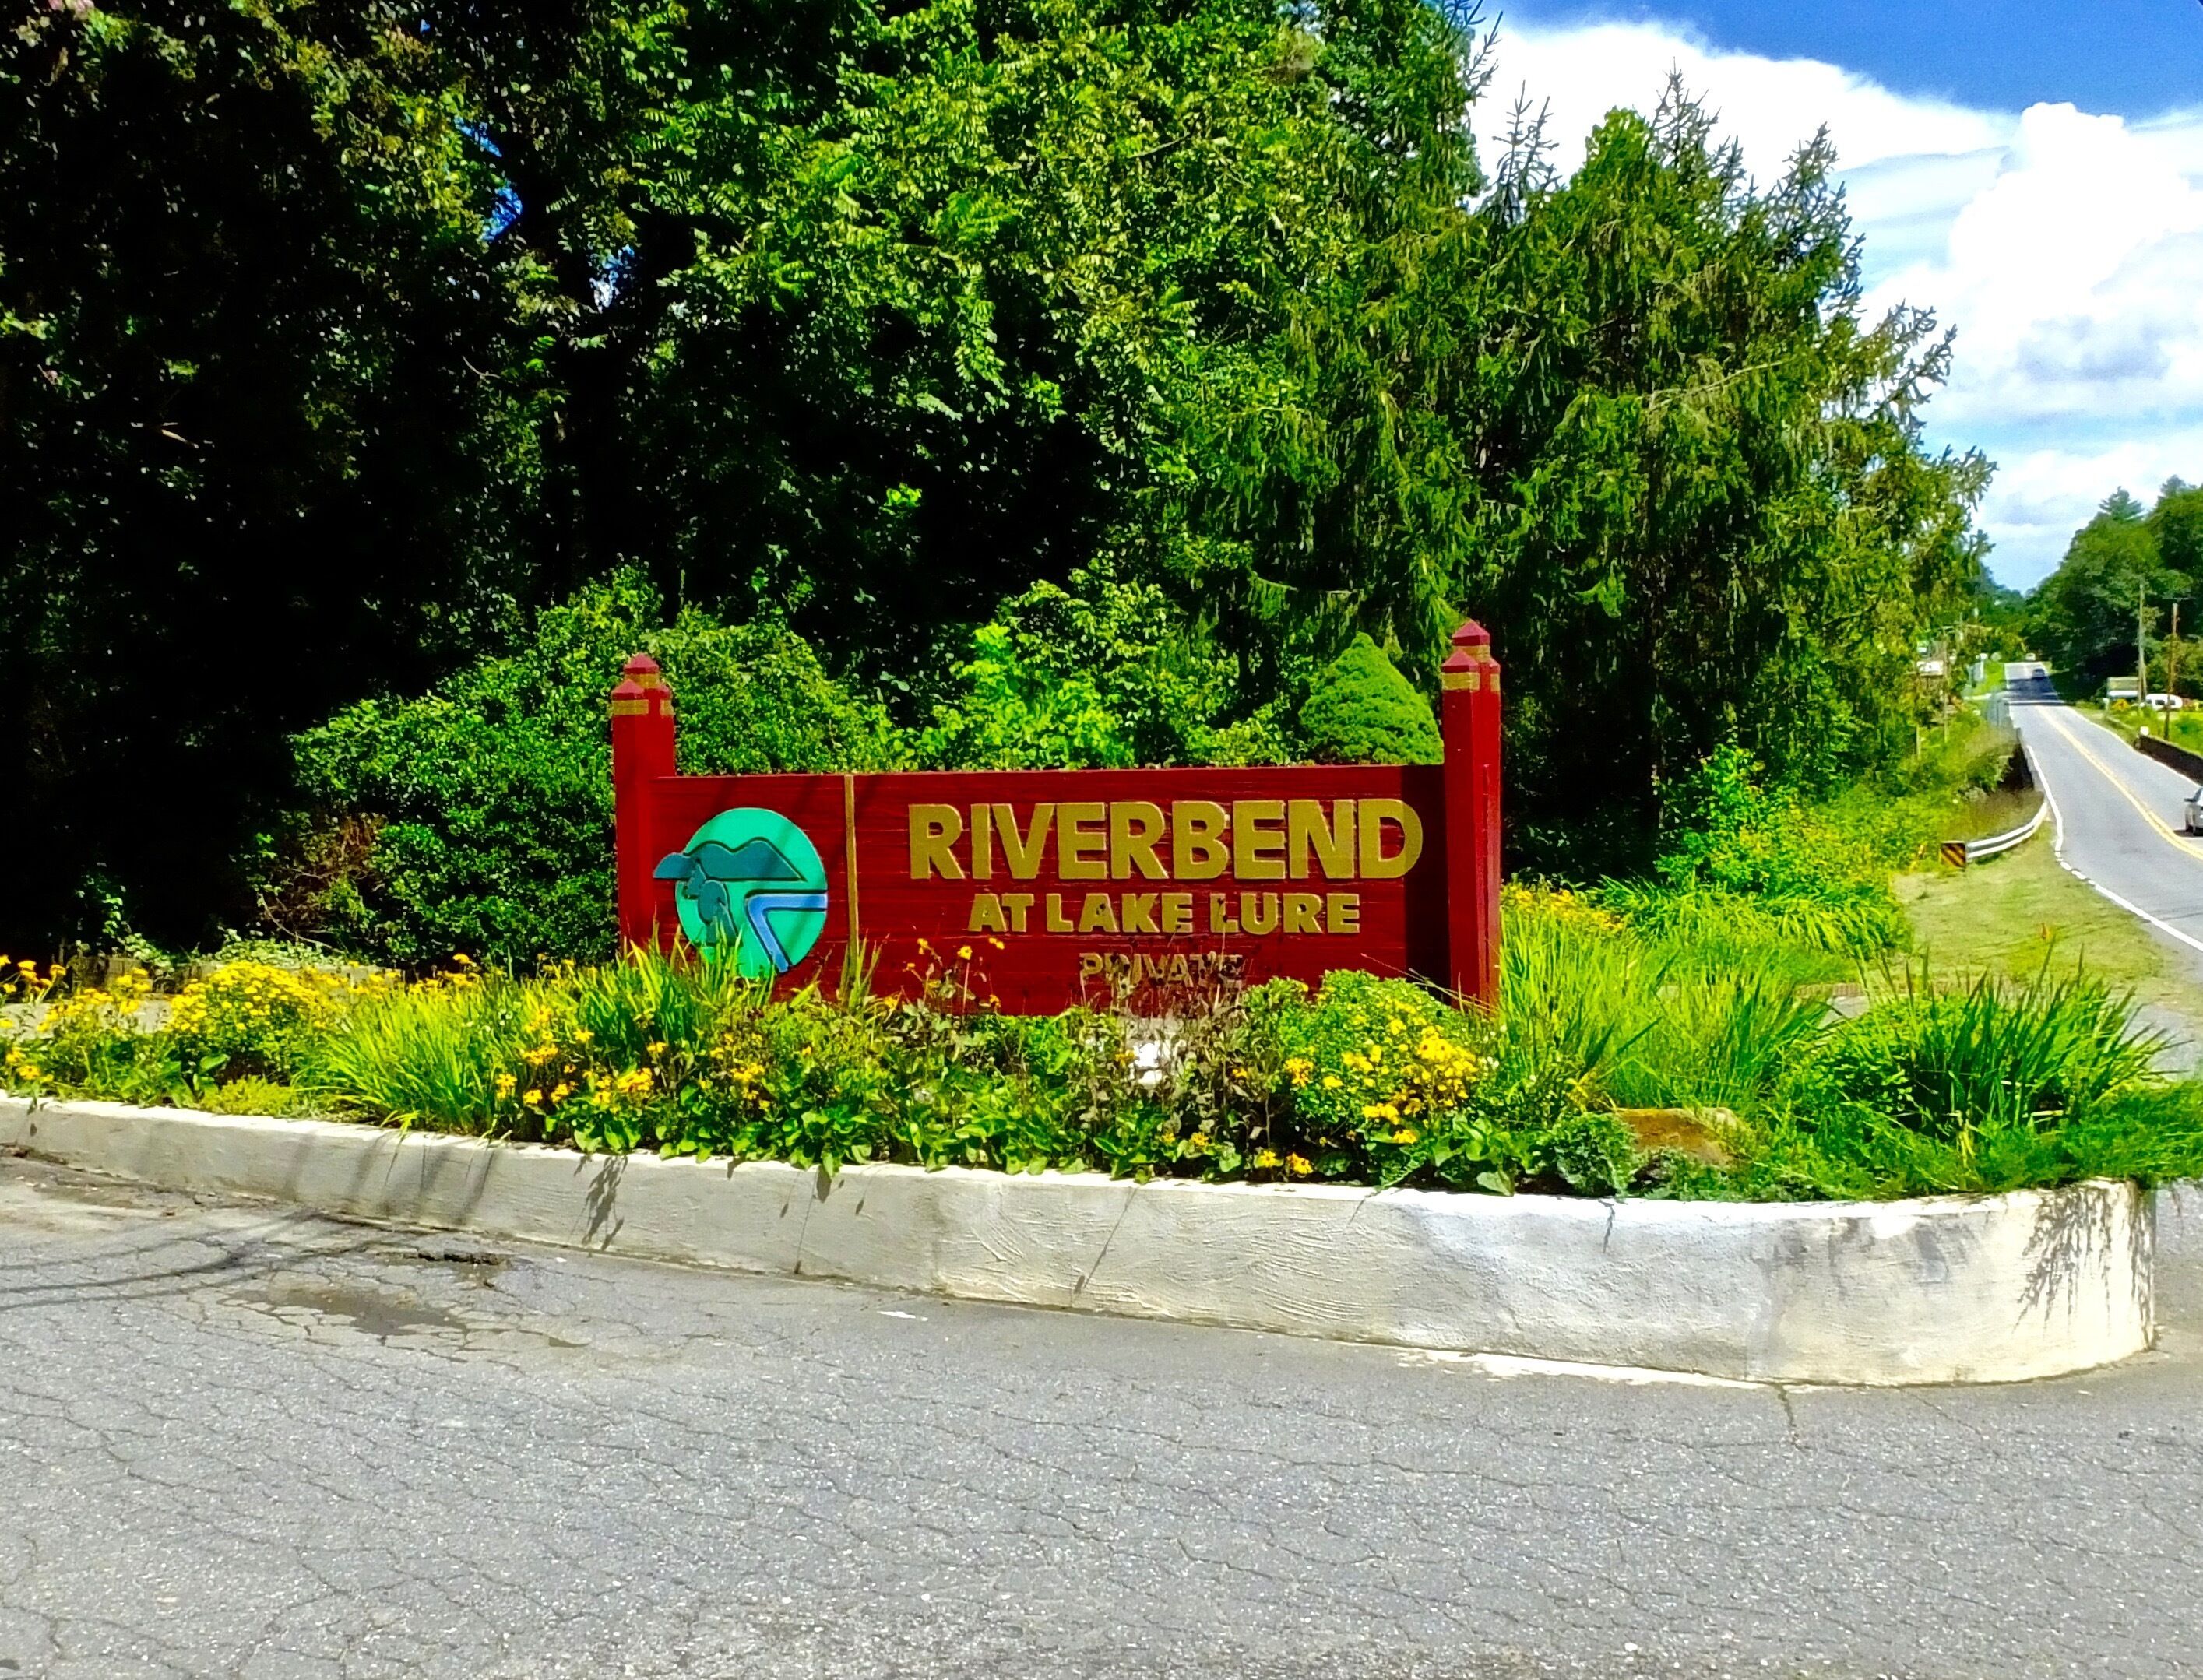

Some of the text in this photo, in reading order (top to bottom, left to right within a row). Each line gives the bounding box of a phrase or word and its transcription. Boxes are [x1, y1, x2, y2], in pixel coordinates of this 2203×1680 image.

[908, 799, 1424, 880] RIVERBEND
[968, 892, 1360, 935] AT LAKE LURE
